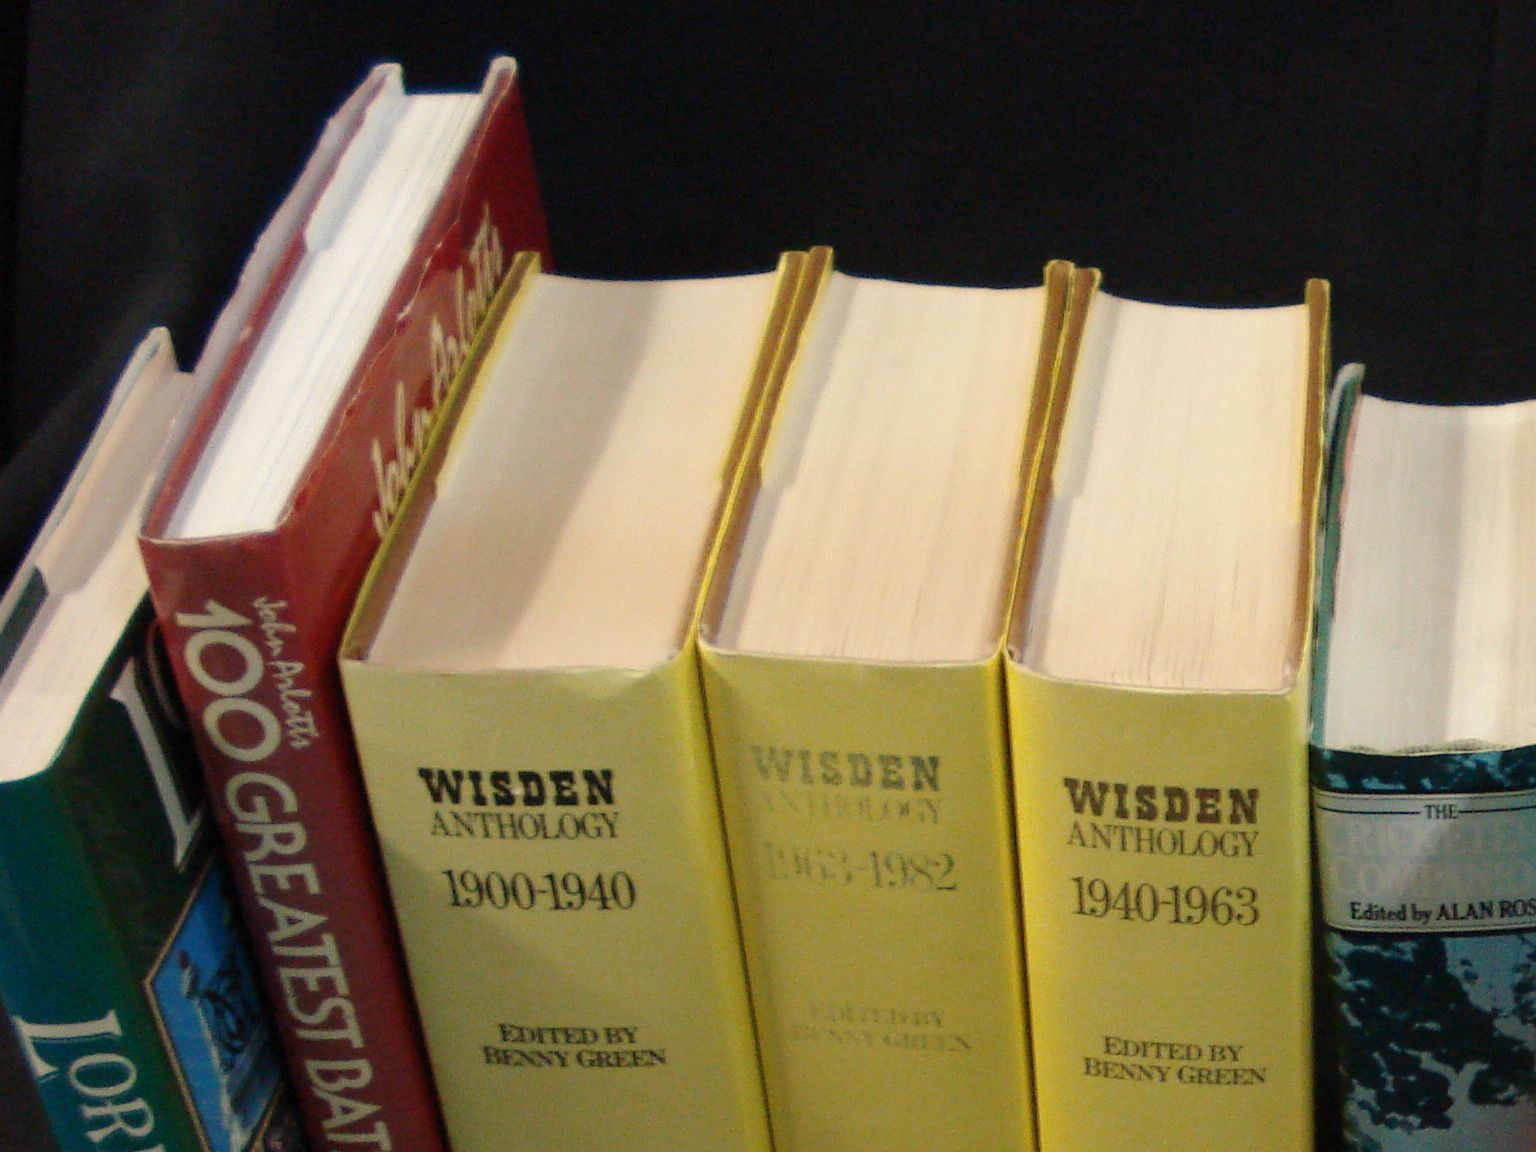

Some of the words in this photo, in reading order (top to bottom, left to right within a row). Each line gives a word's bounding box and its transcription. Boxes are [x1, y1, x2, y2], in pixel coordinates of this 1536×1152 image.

[174, 600, 282, 762] 100
[752, 745, 940, 792] WISDEN
[418, 767, 615, 807] WISDEN
[1064, 778, 1260, 825] WISDEN
[431, 811, 619, 839] ANTHOLOGY
[1424, 803, 1459, 820] THE
[1068, 824, 1259, 858] ANTHOLOGY
[443, 869, 636, 911] 1900-1940
[1071, 876, 1260, 926] 1940-1963
[225, 772, 365, 1048] GREATEST
[1350, 902, 1406, 922] Edited
[1410, 901, 1432, 925] by
[1436, 900, 1495, 921] ALAN
[499, 1023, 599, 1046] EDITED
[605, 1026, 638, 1046] BY
[1104, 1036, 1200, 1063] EDITED
[1208, 1042, 1242, 1063] BY
[483, 1045, 569, 1069] BENNY
[575, 1048, 667, 1069] GREEN
[1084, 1057, 1169, 1084] BENNY
[1177, 1062, 1267, 1086] GREEN
